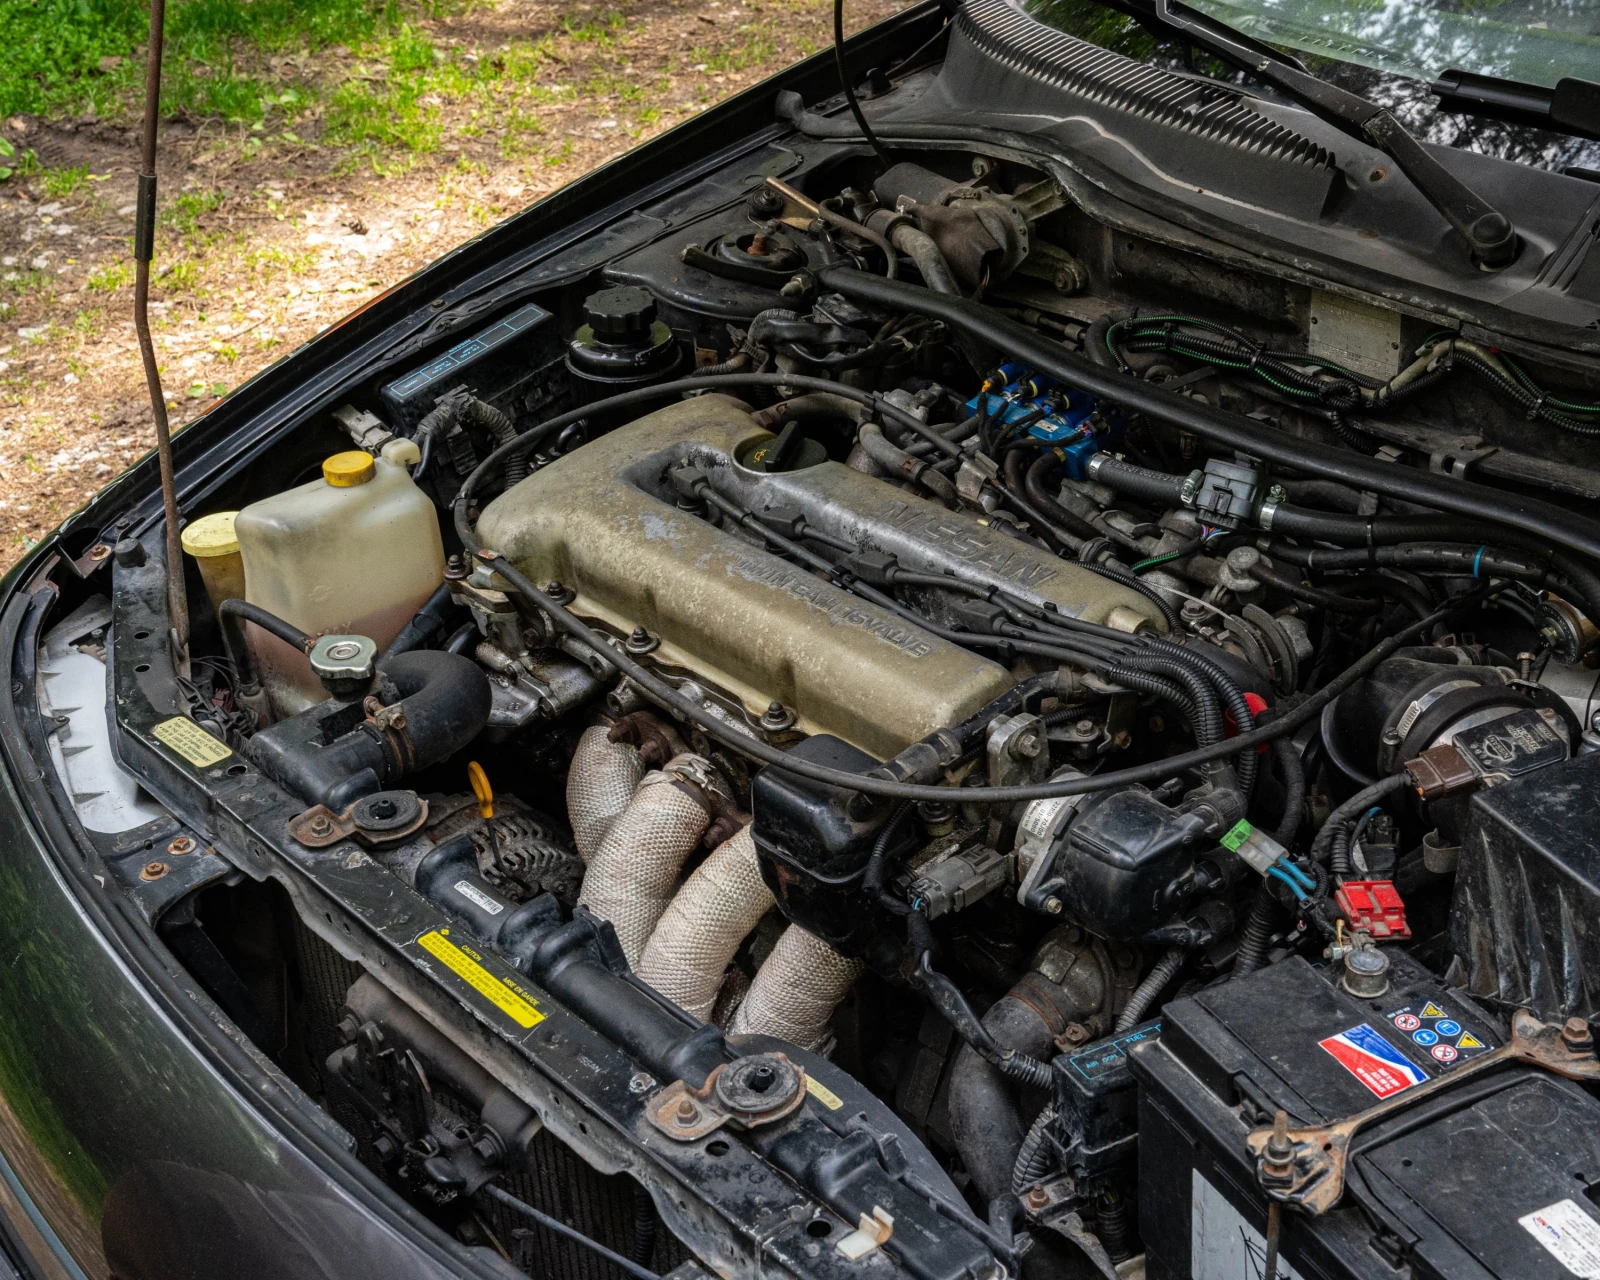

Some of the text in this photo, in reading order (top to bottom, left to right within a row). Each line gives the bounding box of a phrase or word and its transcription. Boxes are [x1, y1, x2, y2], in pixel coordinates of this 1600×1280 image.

[877, 501, 1058, 586] NISSAN
[736, 556, 793, 588] TWIN
[1487, 736, 1511, 759] NISSAN
[461, 945, 483, 961] CAUTION
[503, 977, 540, 1006] MISE EN GARDE
[1125, 1033, 1147, 1044] FUEL
[1086, 1061, 1099, 1069] AIR
